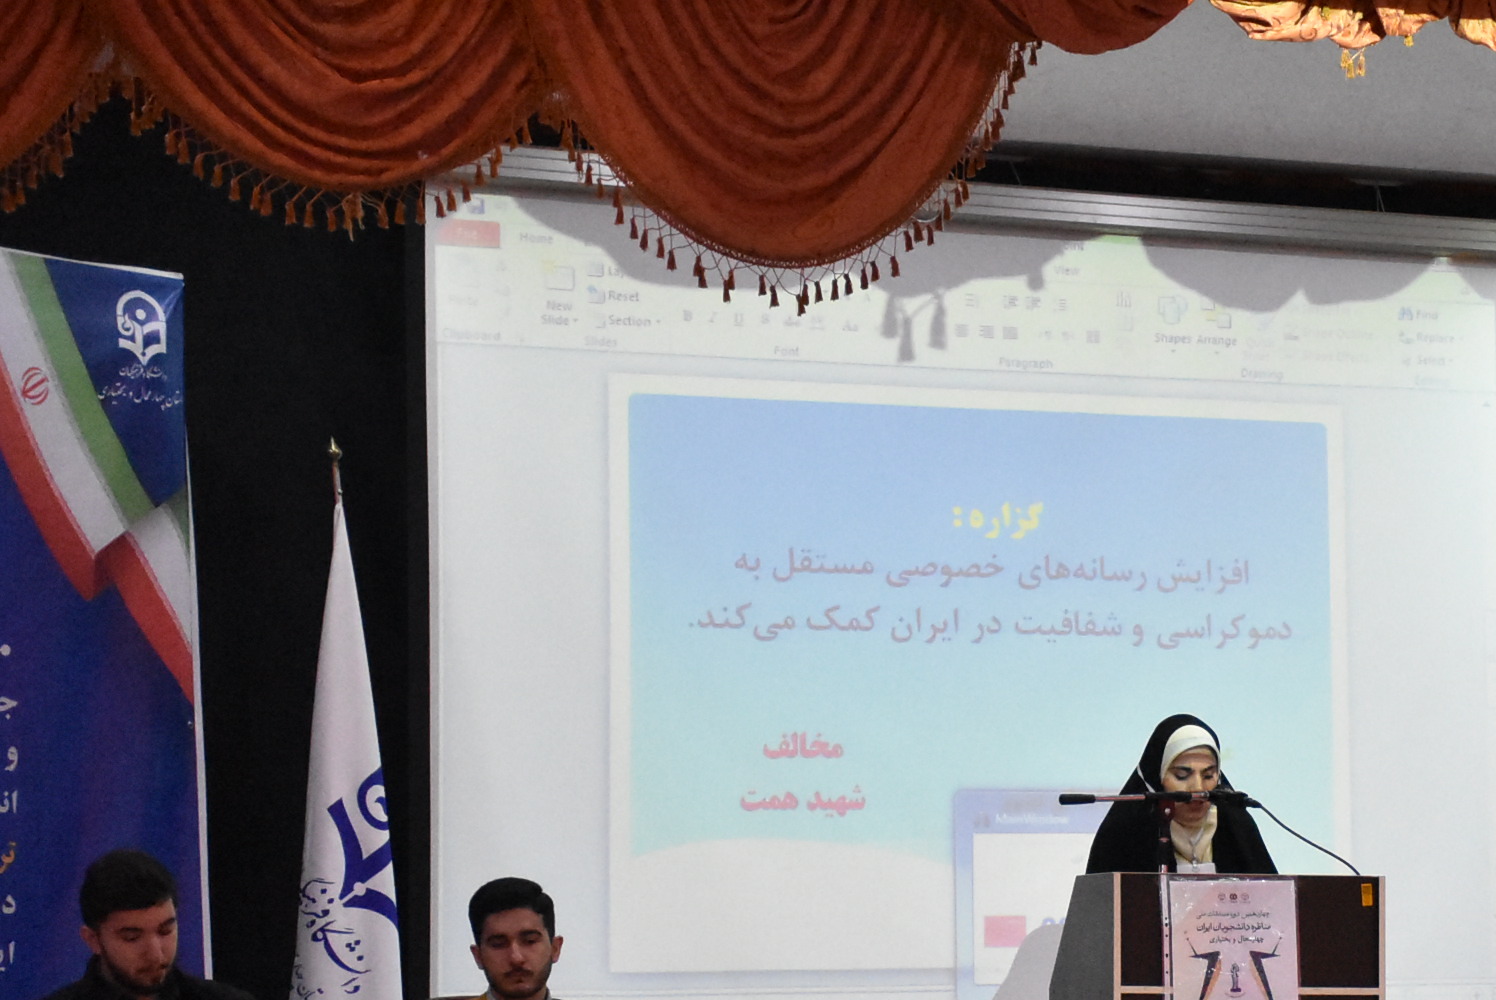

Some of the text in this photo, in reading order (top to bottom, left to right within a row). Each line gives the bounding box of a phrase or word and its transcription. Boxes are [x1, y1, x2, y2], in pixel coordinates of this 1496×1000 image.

[518, 231, 554, 245] Home
[545, 300, 574, 312] New
[607, 289, 640, 303] Reset
[540, 313, 570, 326] Slide
[607, 314, 653, 327] Section
[584, 335, 618, 348] Slides
[1154, 332, 1193, 346] Shapes
[1196, 334, 1238, 348] Arrange
[1416, 332, 1455, 344] Replace
[773, 345, 800, 357] Font
[998, 356, 1054, 370] Paragraph
[1240, 367, 1284, 382] Drawing
[734, 553, 761, 581] به
[772, 547, 875, 583] مستقل
[885, 553, 1005, 588] خصوصی
[1156, 558, 1250, 594] افزایش
[806, 605, 881, 632] کمک
[890, 607, 960, 644] ایران
[1013, 608, 1123, 644] شفافیت
[970, 616, 1003, 644] در
[1131, 621, 1145, 648] و
[1156, 612, 1293, 650] دموکراسی
[762, 731, 845, 760] مخالف
[739, 784, 867, 818] شهید همت
